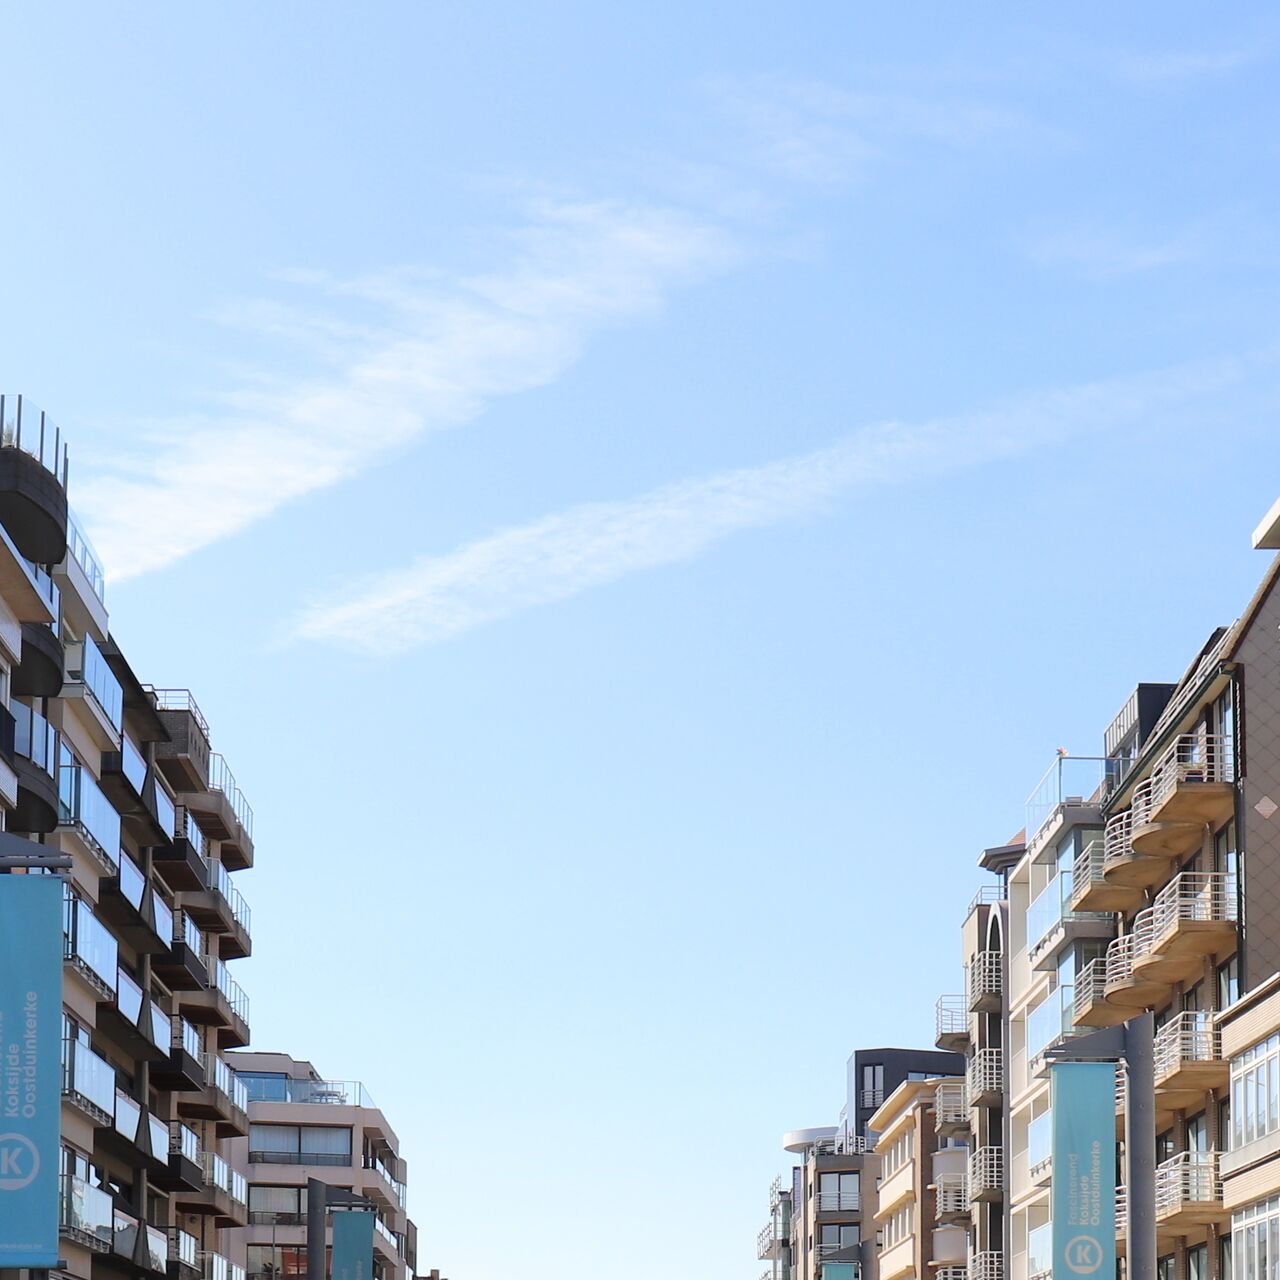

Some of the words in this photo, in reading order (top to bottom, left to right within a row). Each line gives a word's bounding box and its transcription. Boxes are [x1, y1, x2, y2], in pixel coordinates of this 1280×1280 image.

[5, 1043, 21, 1118] Koksijde
[23, 991, 37, 1119] Oostduinkerke
[1, 1148, 22, 1175] K
[1091, 1140, 1100, 1226] Oostduinkerke
[1076, 1245, 1092, 1264] K
